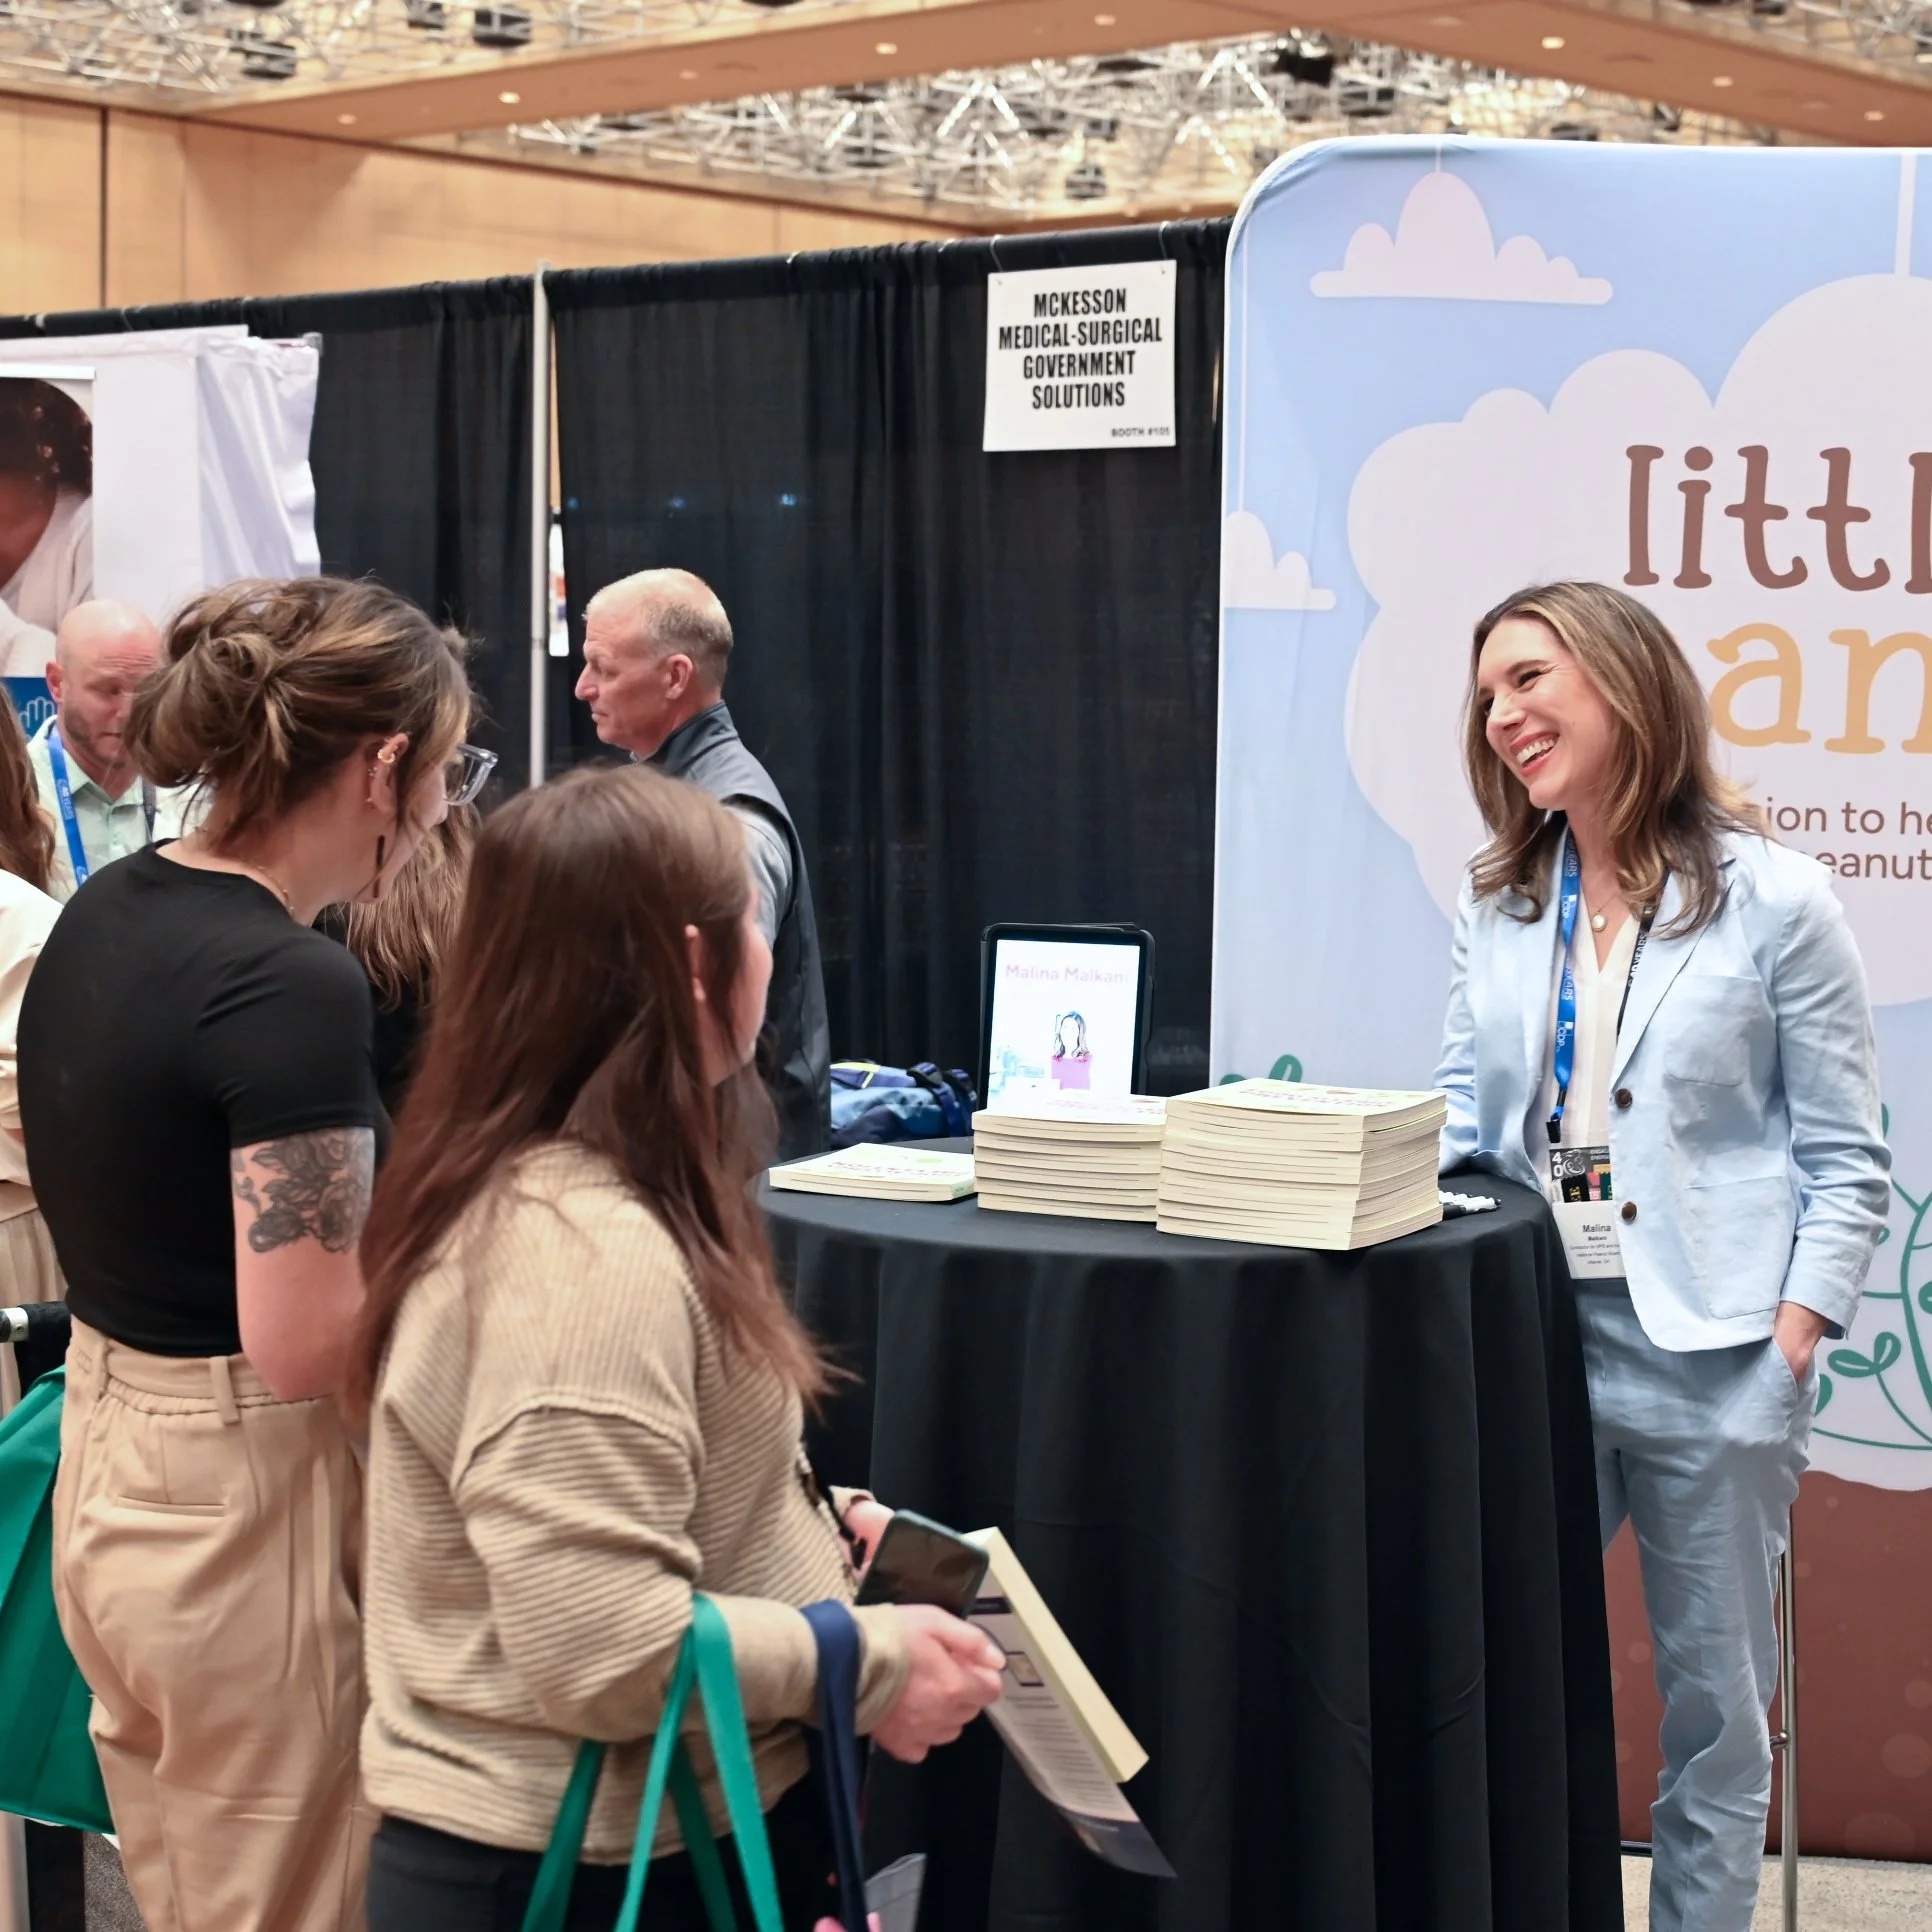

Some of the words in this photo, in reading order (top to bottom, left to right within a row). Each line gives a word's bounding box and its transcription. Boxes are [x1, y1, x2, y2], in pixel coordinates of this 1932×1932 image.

[1034, 288, 1127, 318] MCKESSON
[999, 317, 1162, 350] MEDICAL-SURGICAL
[1023, 350, 1136, 380] GOVERNMENT
[1032, 382, 1126, 410] SOLUTIONS
[1111, 428, 1145, 438] BOOTH
[1841, 801, 1885, 834] to
[1900, 801, 1932, 835] h
[1005, 964, 1059, 980] Malina
[1064, 967, 1128, 984] Malkani
[1582, 1224, 1611, 1233] Malina
